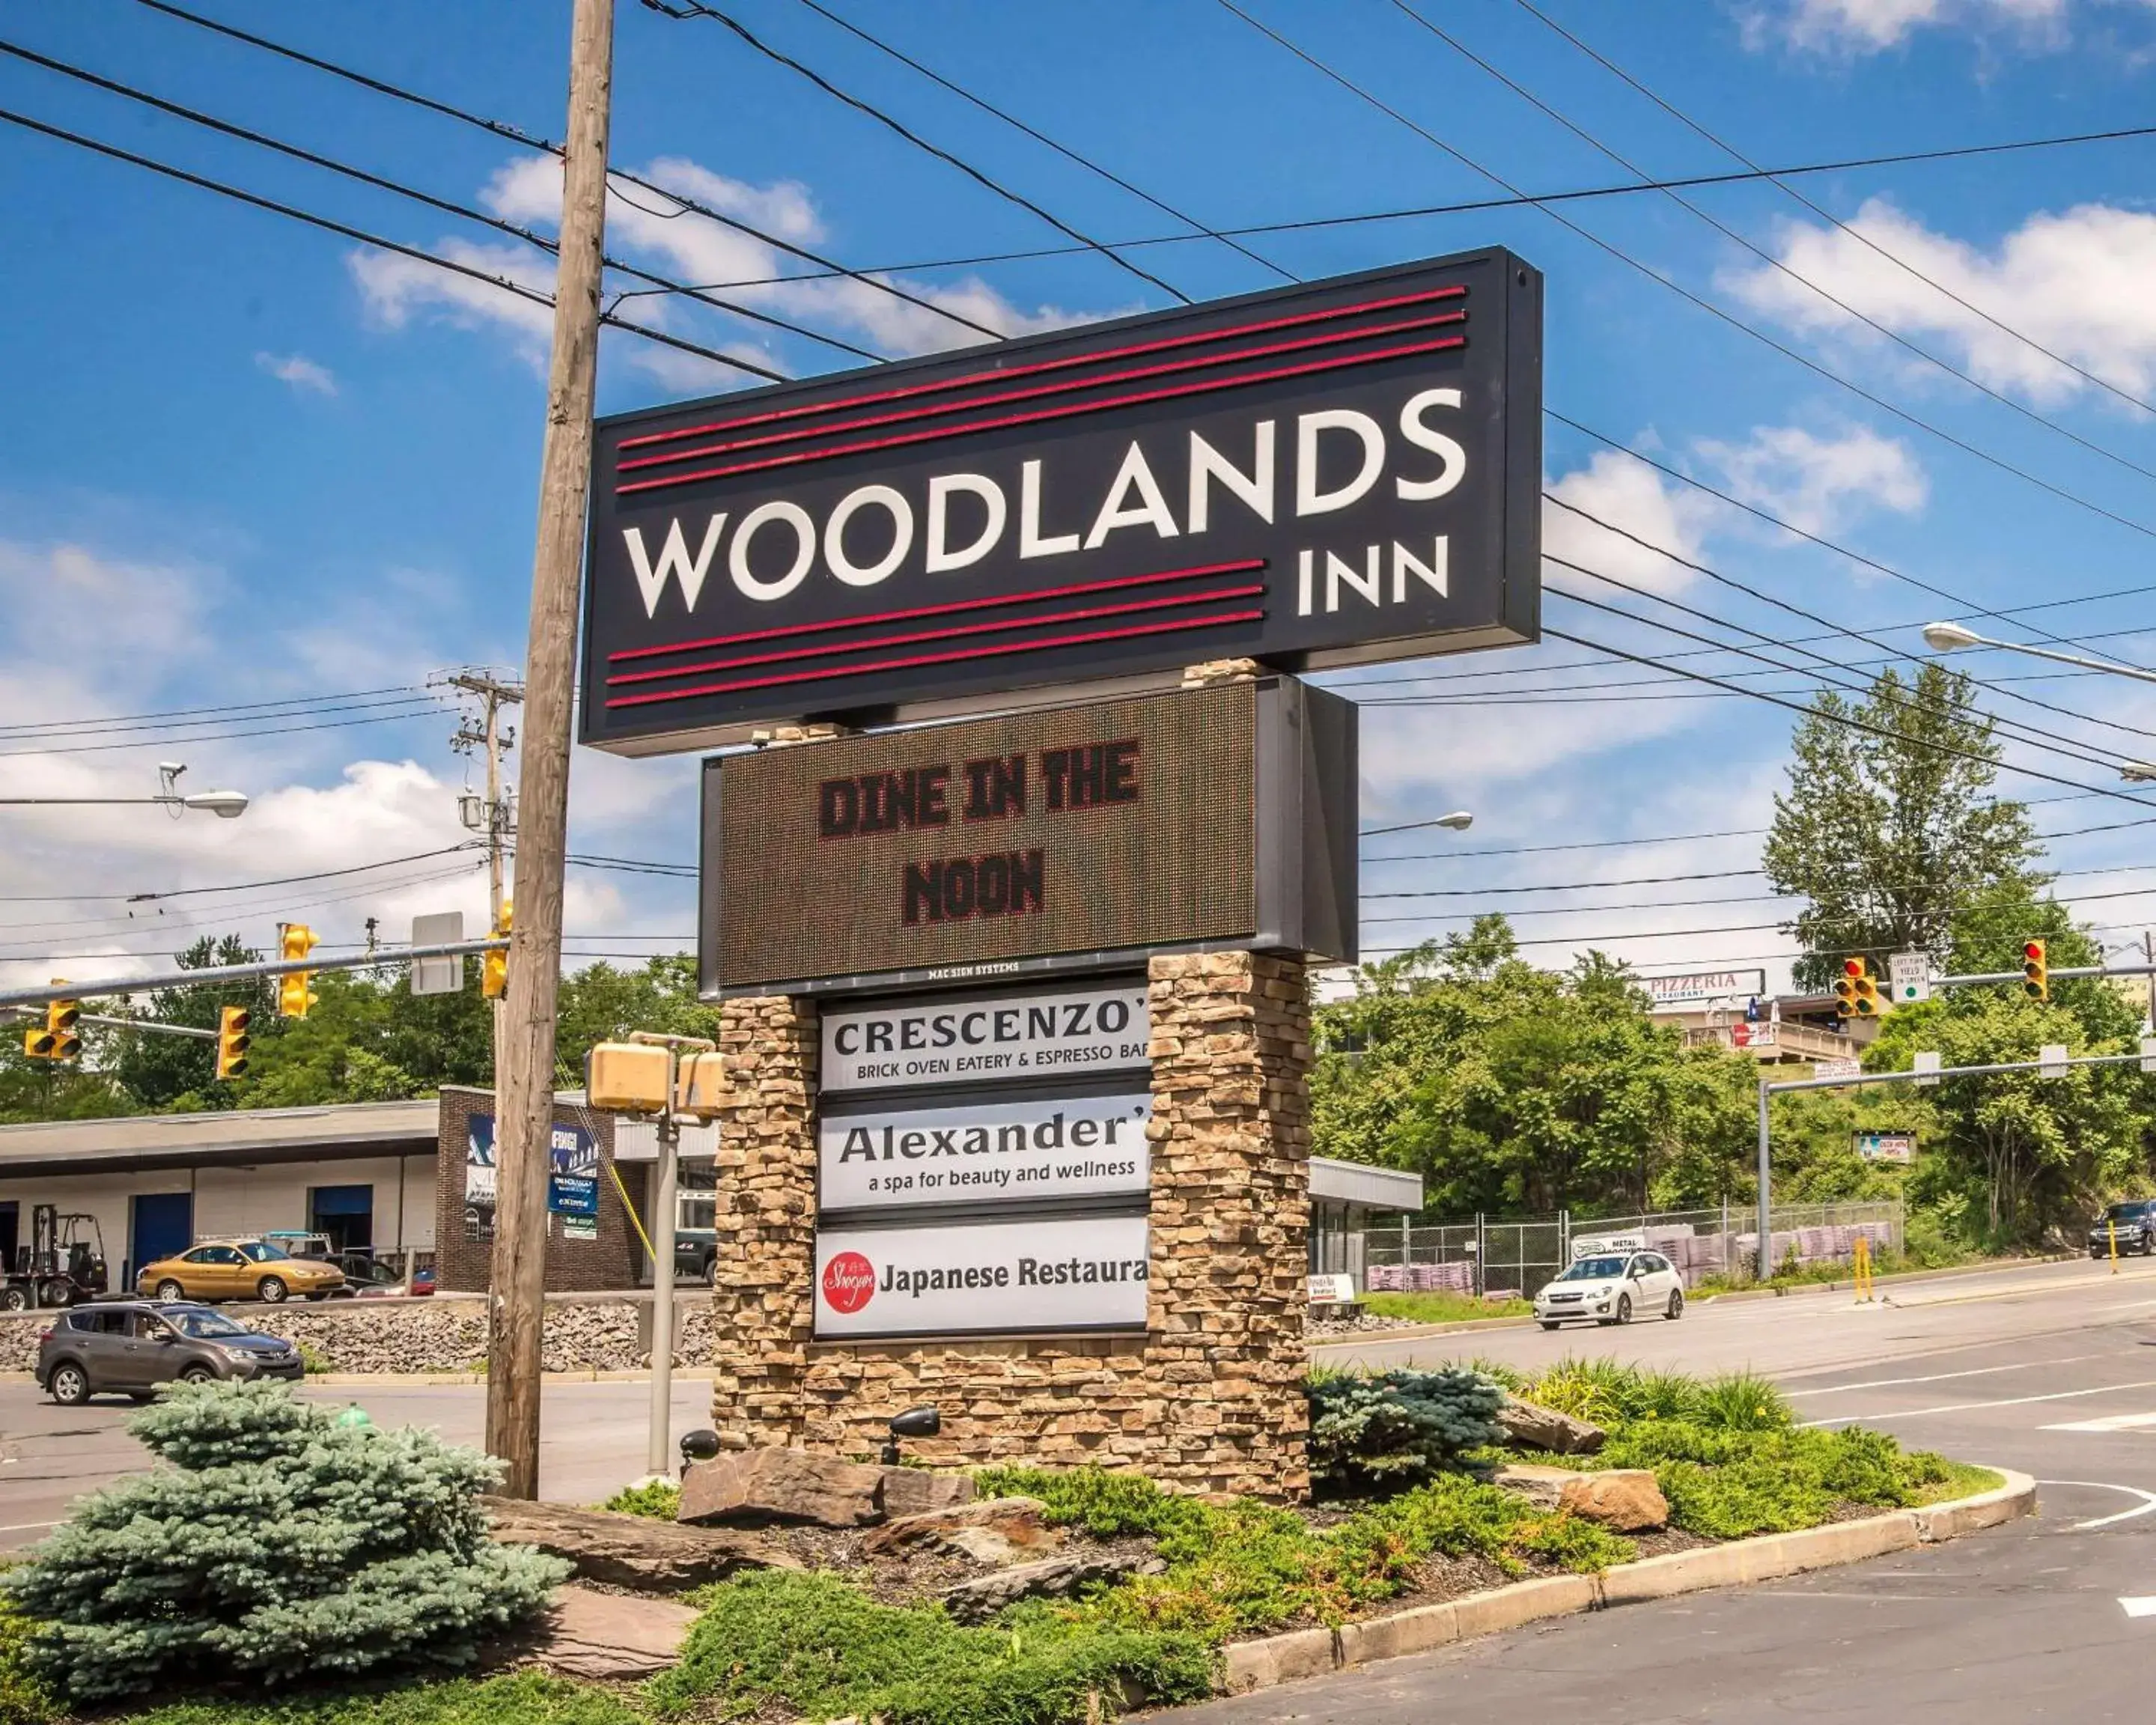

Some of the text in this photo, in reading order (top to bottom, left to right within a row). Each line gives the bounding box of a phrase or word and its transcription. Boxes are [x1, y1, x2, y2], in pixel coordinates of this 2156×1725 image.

[623, 389, 1466, 620] WOODLANDS
[1298, 536, 1448, 616] INN
[819, 740, 1140, 841] DINE IN THE
[902, 849, 1045, 927] NOON
[929, 961, 1019, 980] MAC SIGN SYSTEMS
[1651, 974, 1737, 993] PIZZERIA
[1900, 967, 1920, 975] YIELD
[1655, 990, 1705, 1000] STAURANT
[834, 997, 1145, 1056] CRESCENZO'
[856, 1062, 900, 1080] BRICK
[906, 1059, 950, 1076] OVEN
[955, 1053, 1014, 1072] EATERY
[1018, 1051, 1029, 1067] &
[1035, 1044, 1113, 1065] ESPRESSO
[838, 1105, 1145, 1164] Alexander'
[868, 1160, 1136, 1193] a spa for beauty and wellness
[1612, 1239, 1636, 1247] METAL
[880, 1263, 1009, 1297] Japanese
[1018, 1256, 1148, 1288] Restaura
